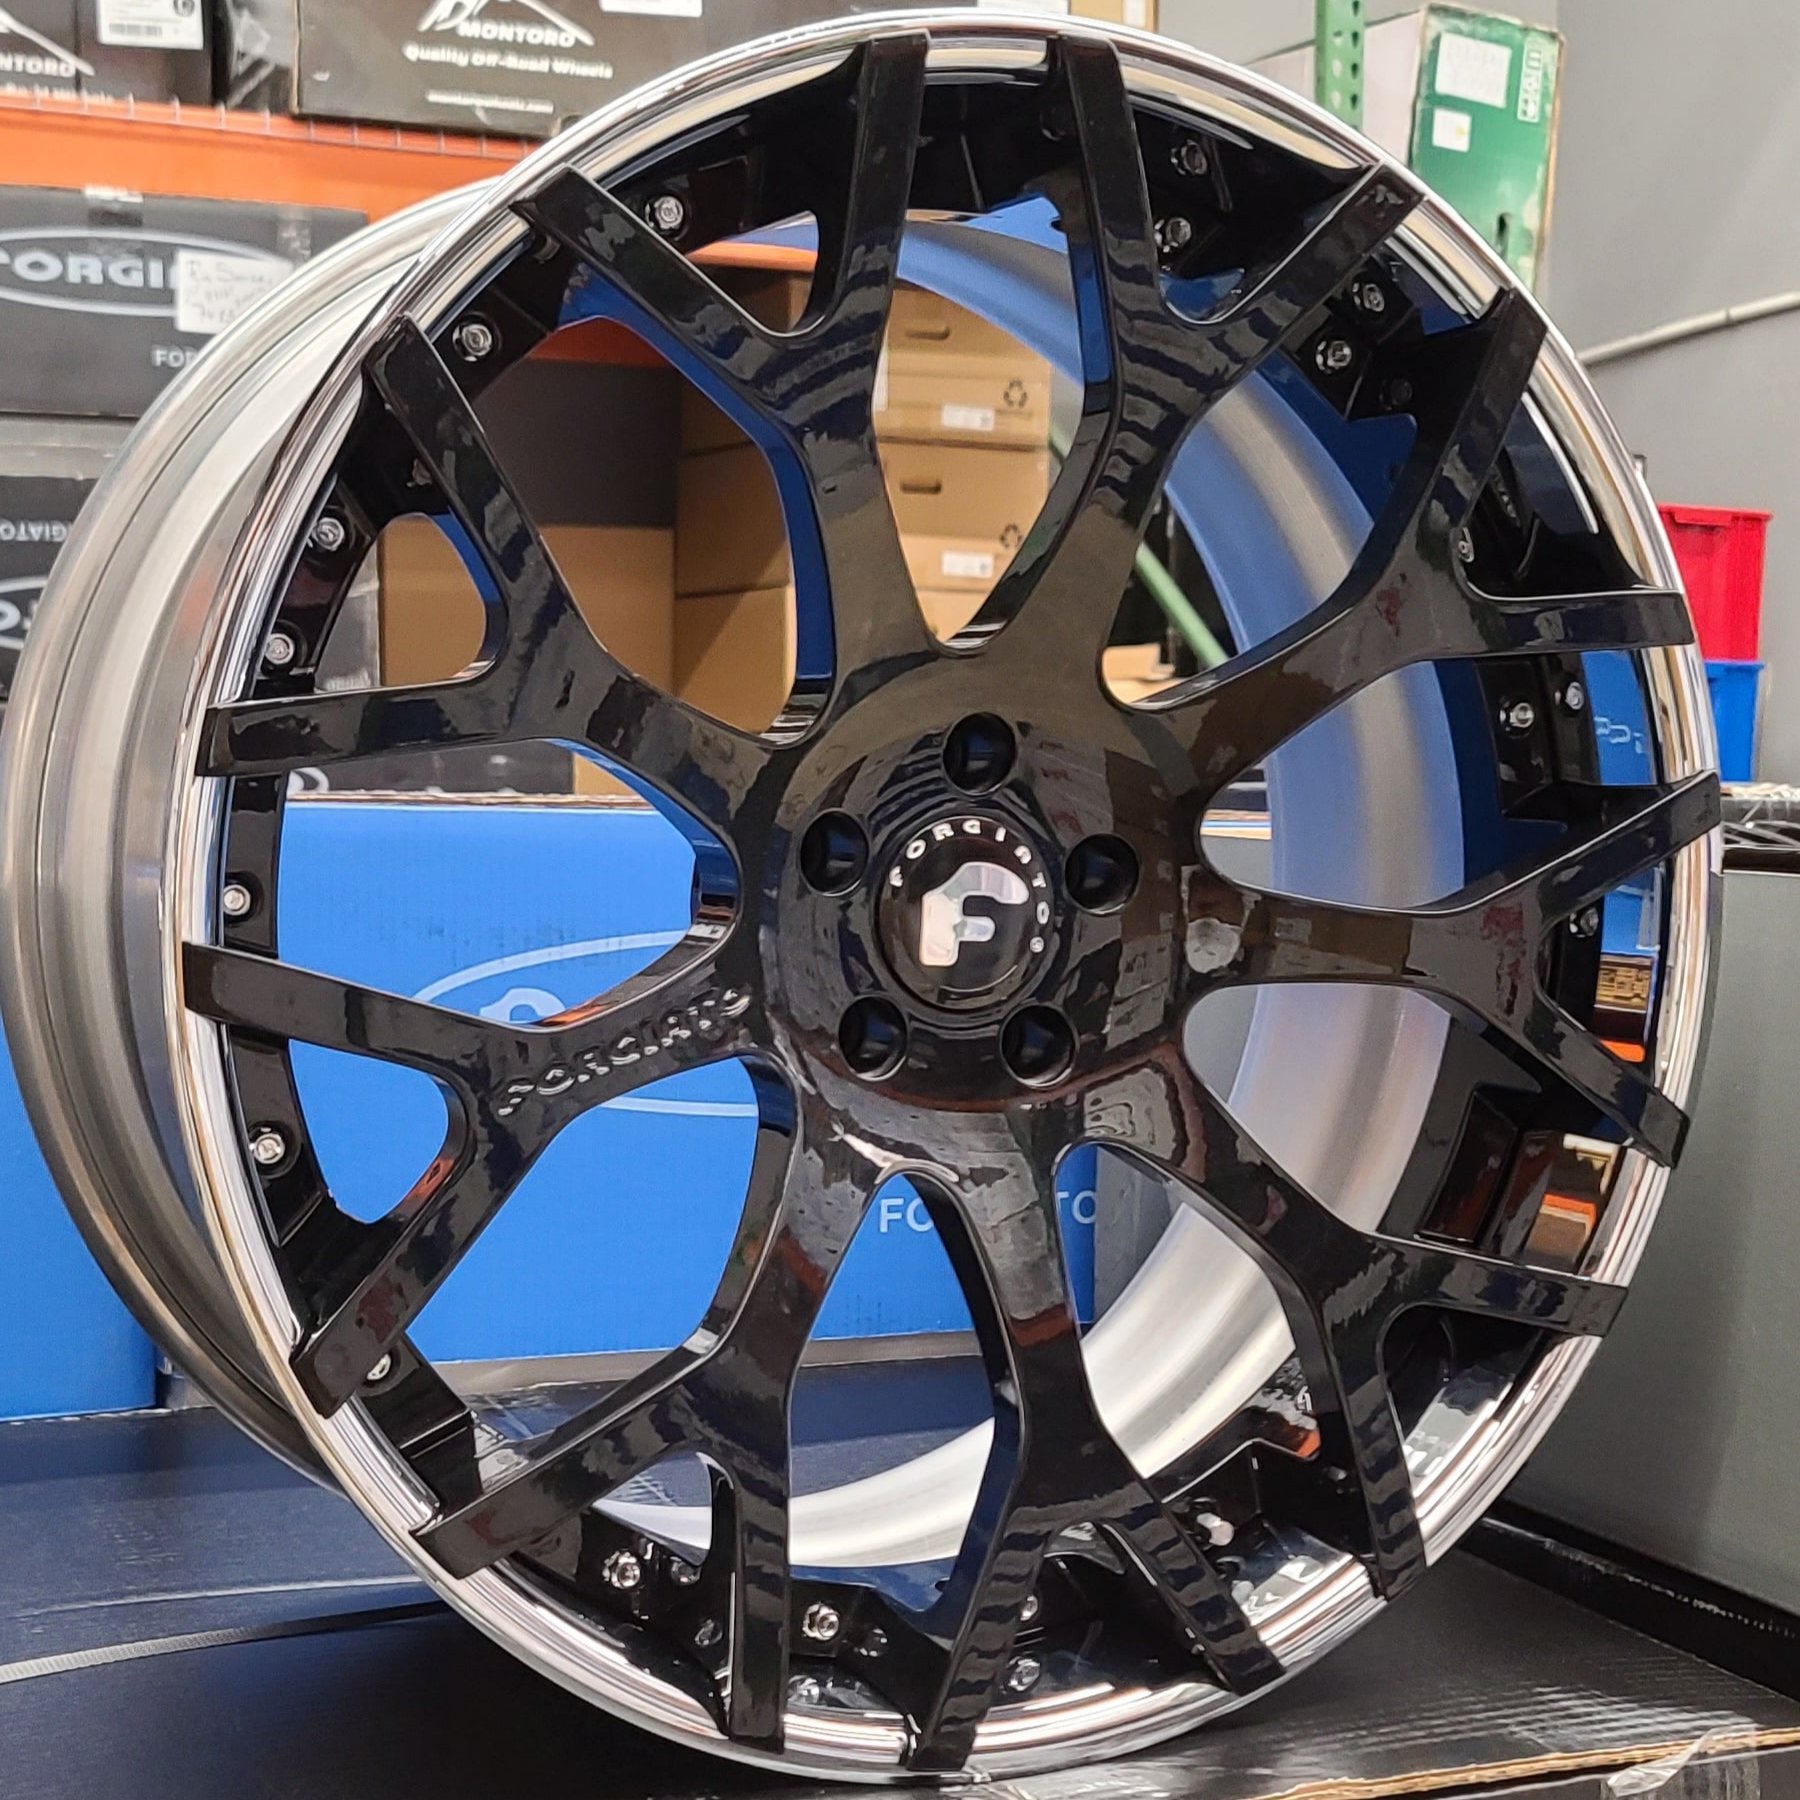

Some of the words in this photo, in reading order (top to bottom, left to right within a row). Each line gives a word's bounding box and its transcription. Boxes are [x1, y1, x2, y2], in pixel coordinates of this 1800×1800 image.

[456, 19, 576, 48] MONTORO
[403, 43, 470, 67] Quality
[0, 251, 178, 289] ORGI
[0, 518, 74, 543] GIATO
